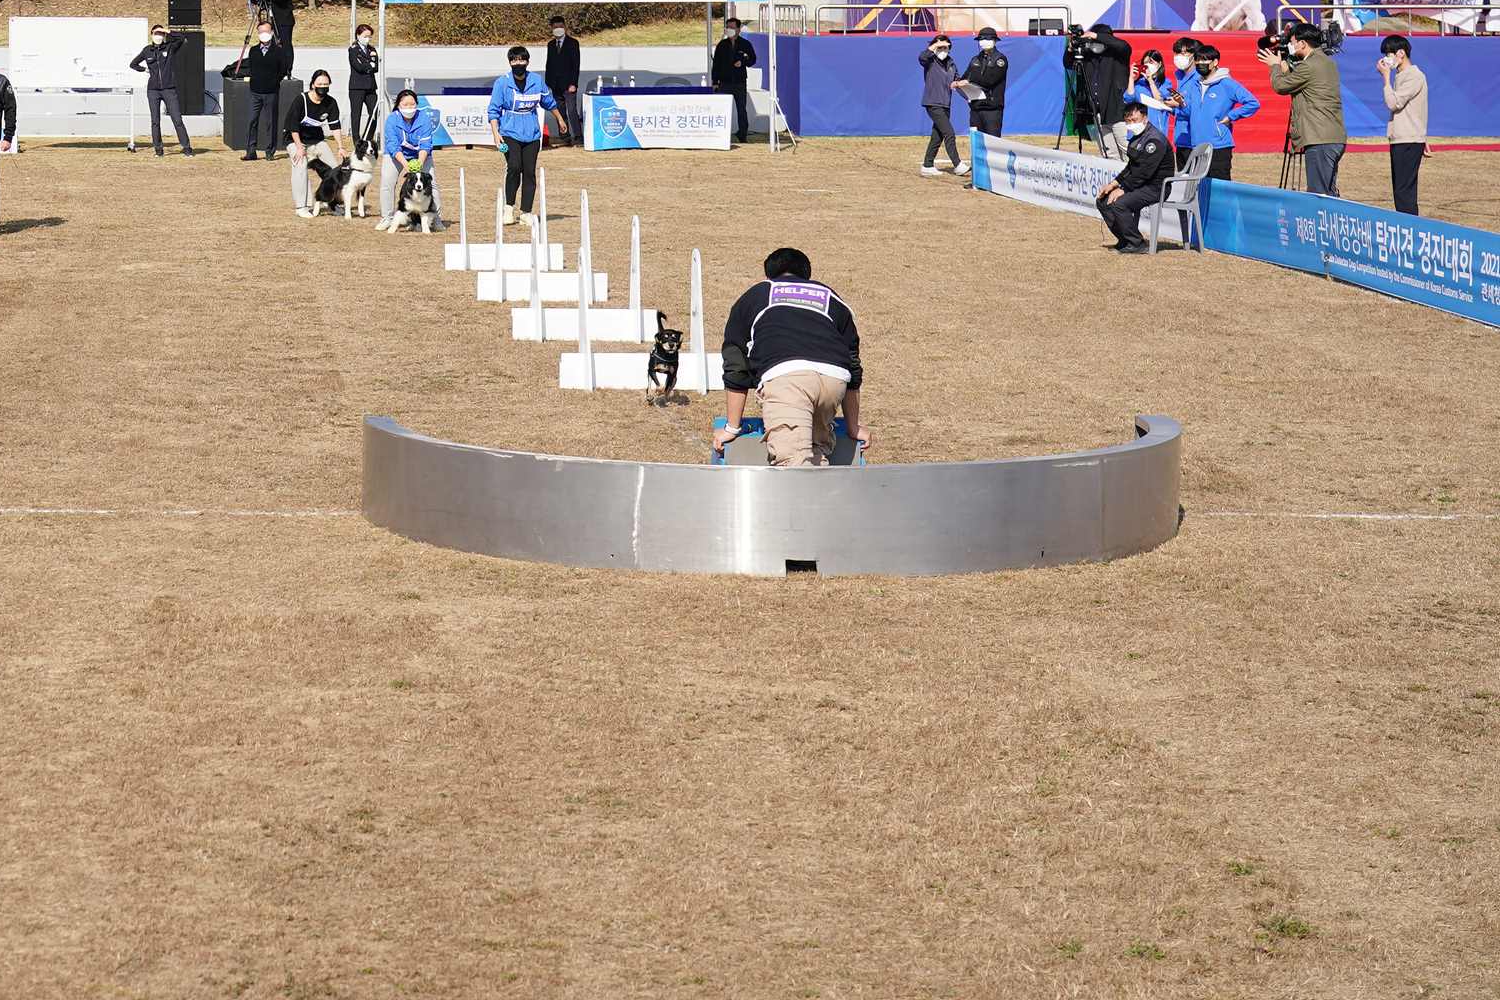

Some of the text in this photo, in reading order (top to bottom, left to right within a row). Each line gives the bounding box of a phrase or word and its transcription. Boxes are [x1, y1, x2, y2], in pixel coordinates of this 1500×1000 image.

[445, 115, 483, 128] 탐지견
[632, 115, 670, 129] 탐지견
[676, 114, 727, 129] 경진대회
[1295, 216, 1318, 248] 제8회
[1317, 209, 1373, 260] 관세청장배
[1375, 221, 1414, 270] 탐지견
[1418, 231, 1473, 287] 경진대회
[774, 287, 826, 300] HELPER
